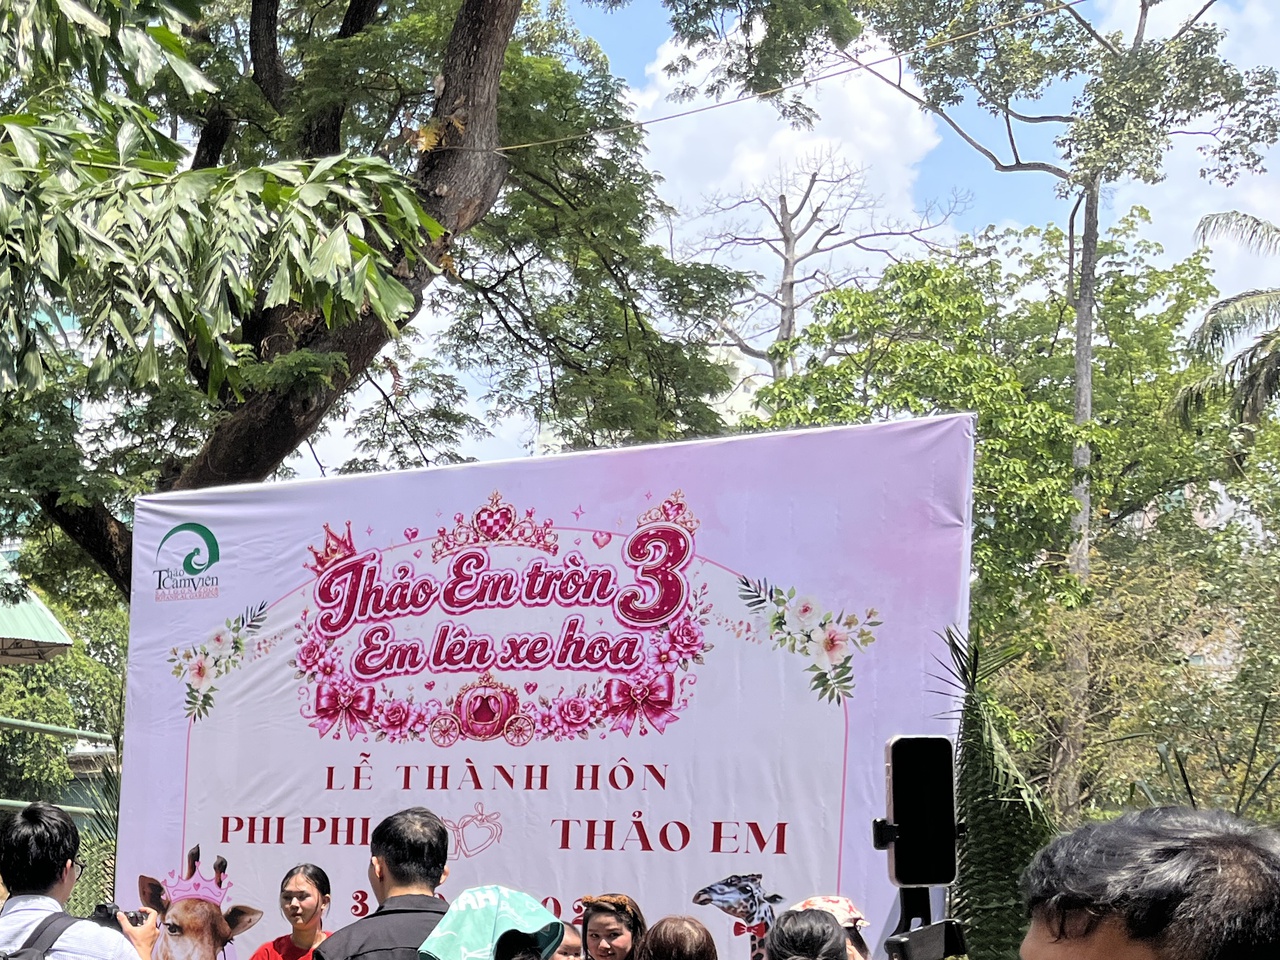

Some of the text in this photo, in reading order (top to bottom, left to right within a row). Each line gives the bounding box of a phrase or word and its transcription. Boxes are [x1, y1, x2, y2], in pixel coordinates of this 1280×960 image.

[318, 524, 692, 635] Thảo Em tròn 3
[354, 618, 642, 675] Em lên xe hoa
[325, 752, 669, 792] LỄ THÀNH HÔN
[220, 810, 790, 855] PHI PHI THẢO EM
